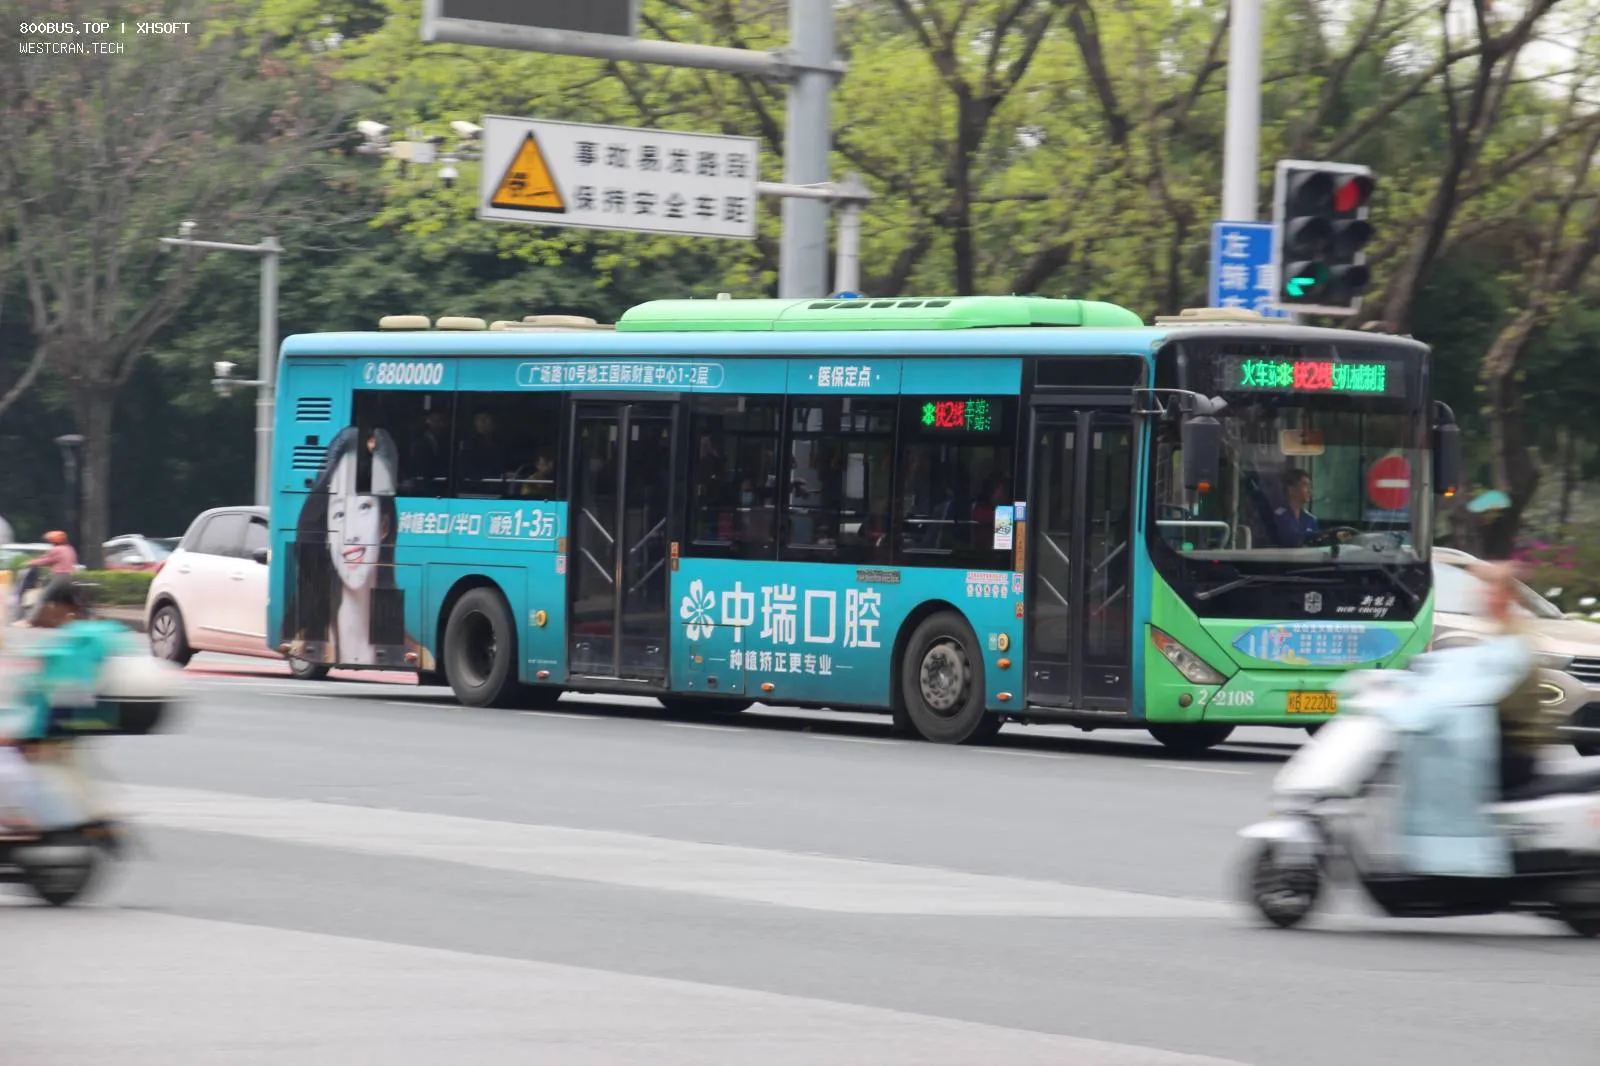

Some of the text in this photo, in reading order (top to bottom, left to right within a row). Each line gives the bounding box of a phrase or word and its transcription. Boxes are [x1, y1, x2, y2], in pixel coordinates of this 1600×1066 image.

[575, 141, 749, 178] 事故易发路段
[574, 185, 747, 223] 保持安全车距
[376, 362, 444, 385] 8800000
[528, 364, 709, 385] 广场路10号地王国际财富中心1-2层
[817, 365, 872, 388] 医保定点
[721, 581, 882, 648] 中瑞口腔
[729, 649, 833, 675] 种植矫正更专业
